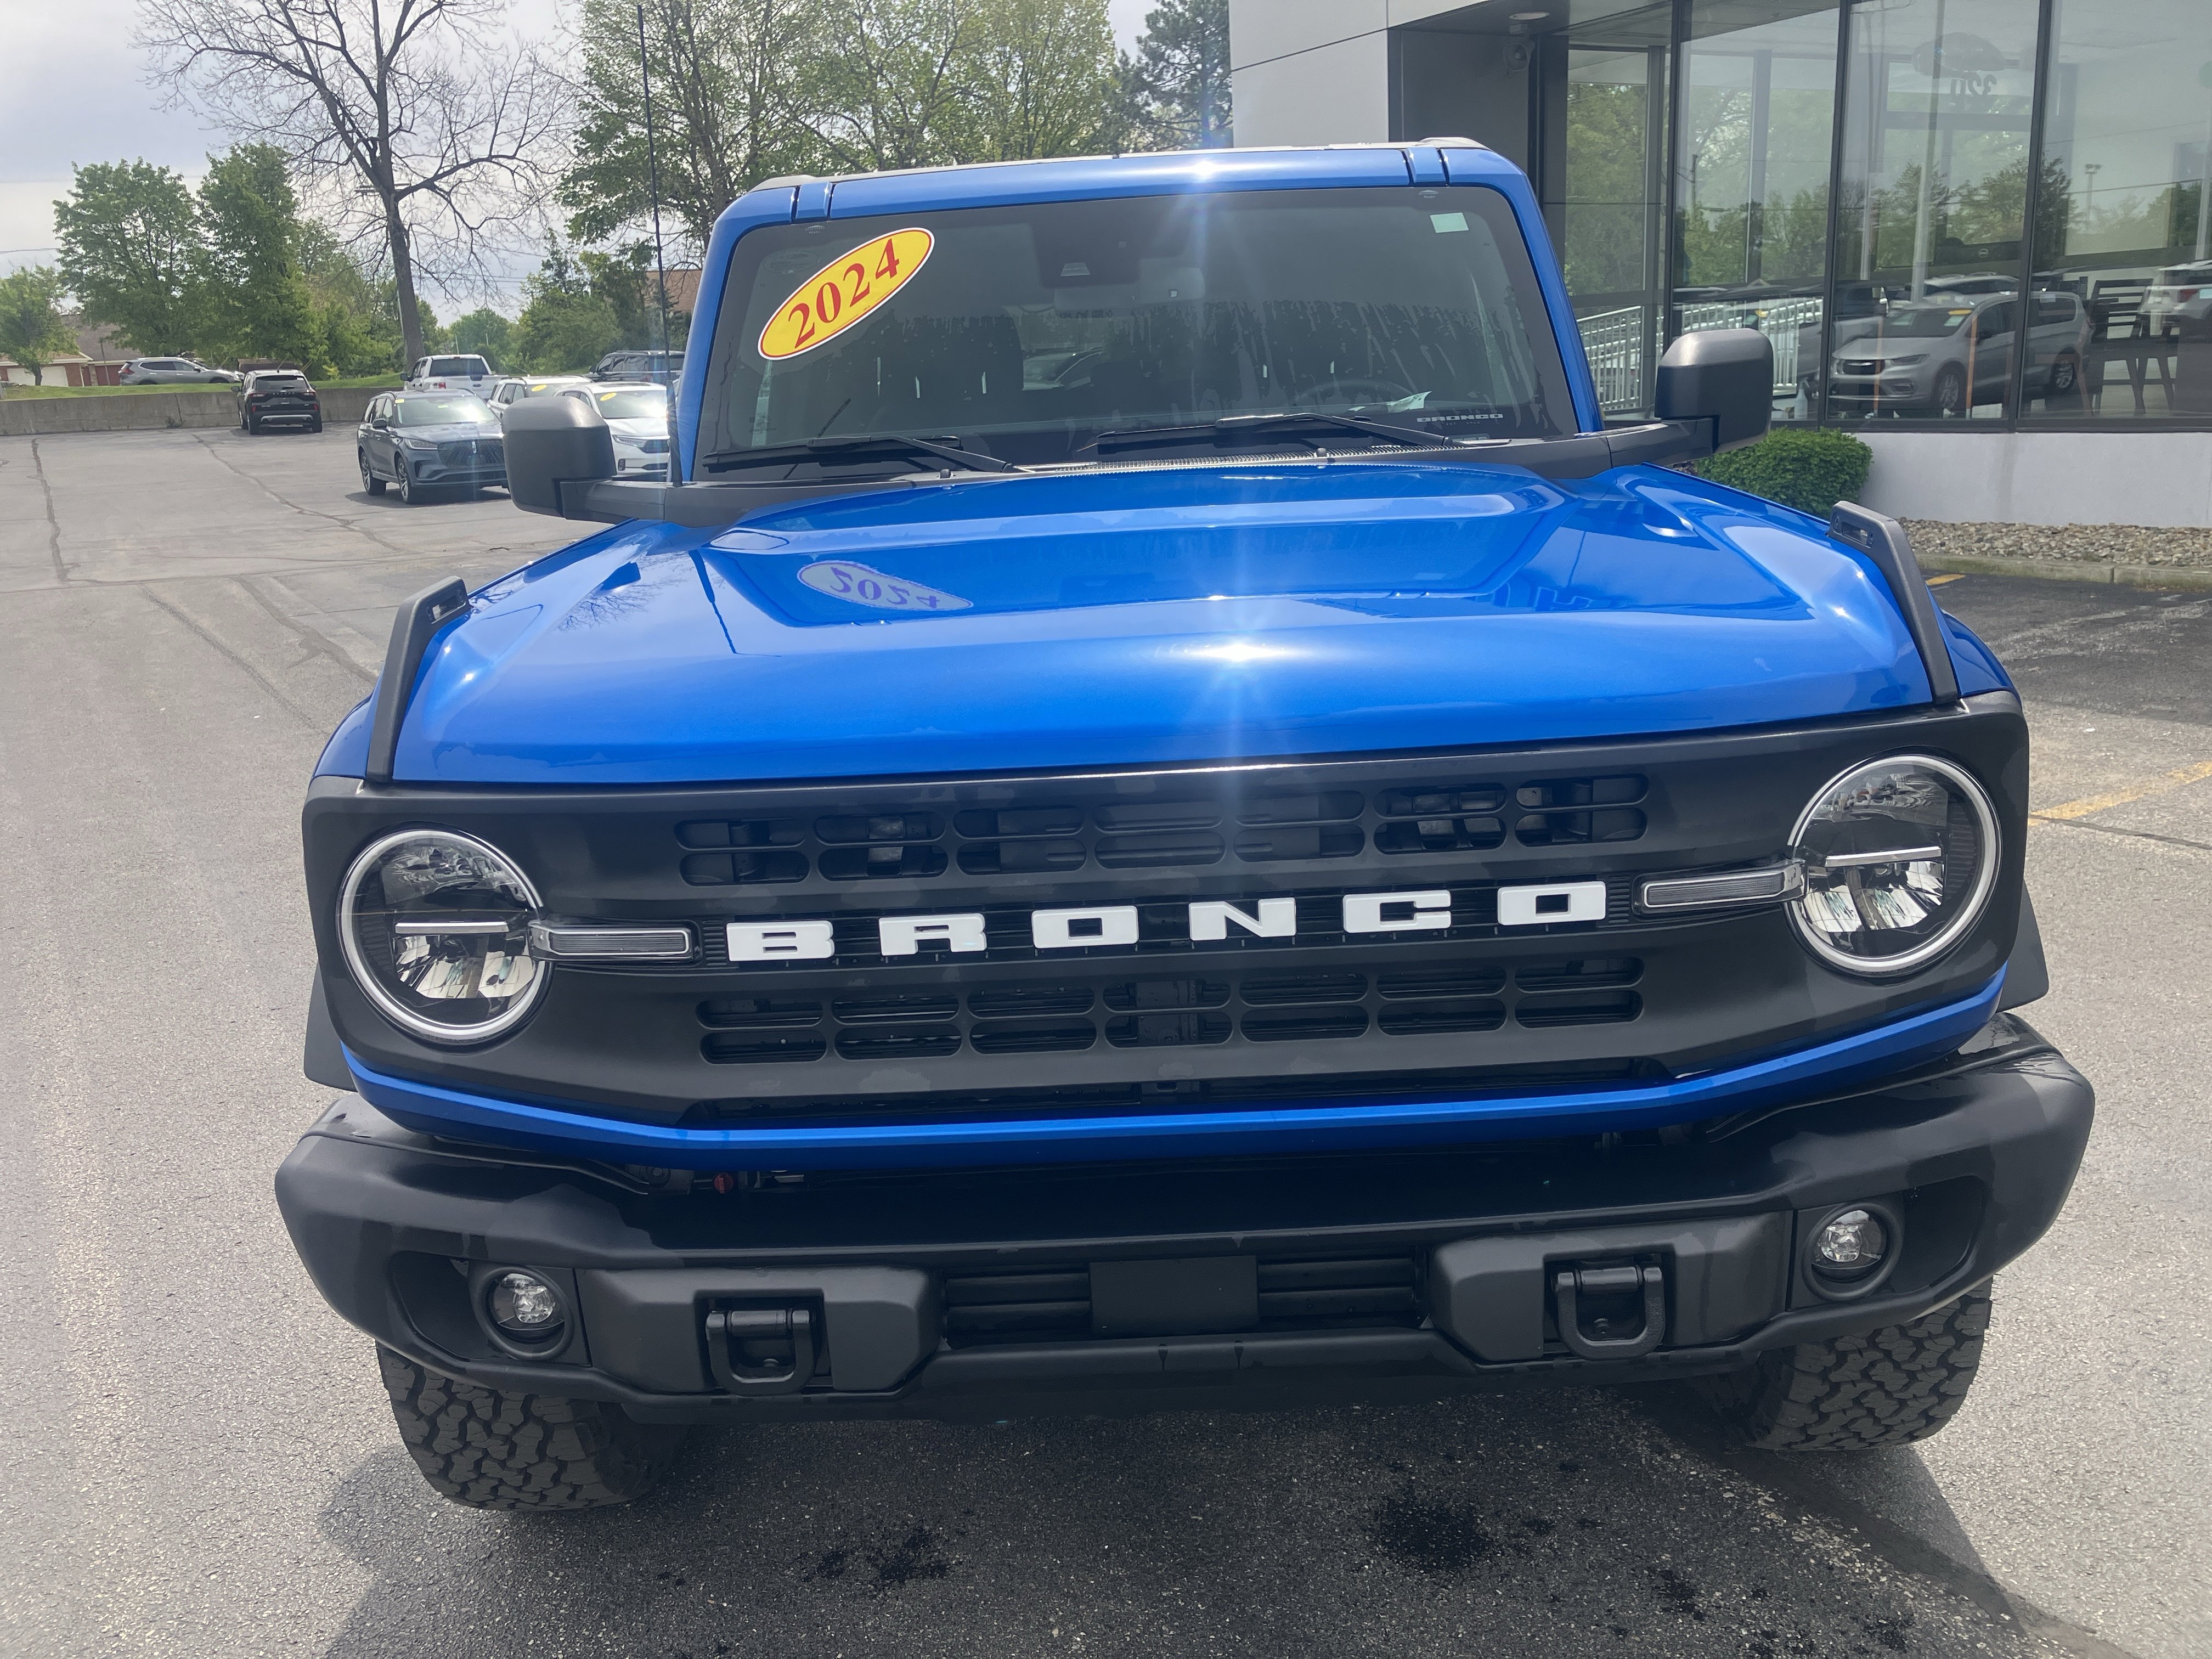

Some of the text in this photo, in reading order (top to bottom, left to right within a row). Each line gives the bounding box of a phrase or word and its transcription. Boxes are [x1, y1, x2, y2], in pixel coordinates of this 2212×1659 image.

[788, 238, 900, 349] 2024
[1417, 413, 1504, 422] BRONCO
[726, 881, 1607, 962] BRONCO
